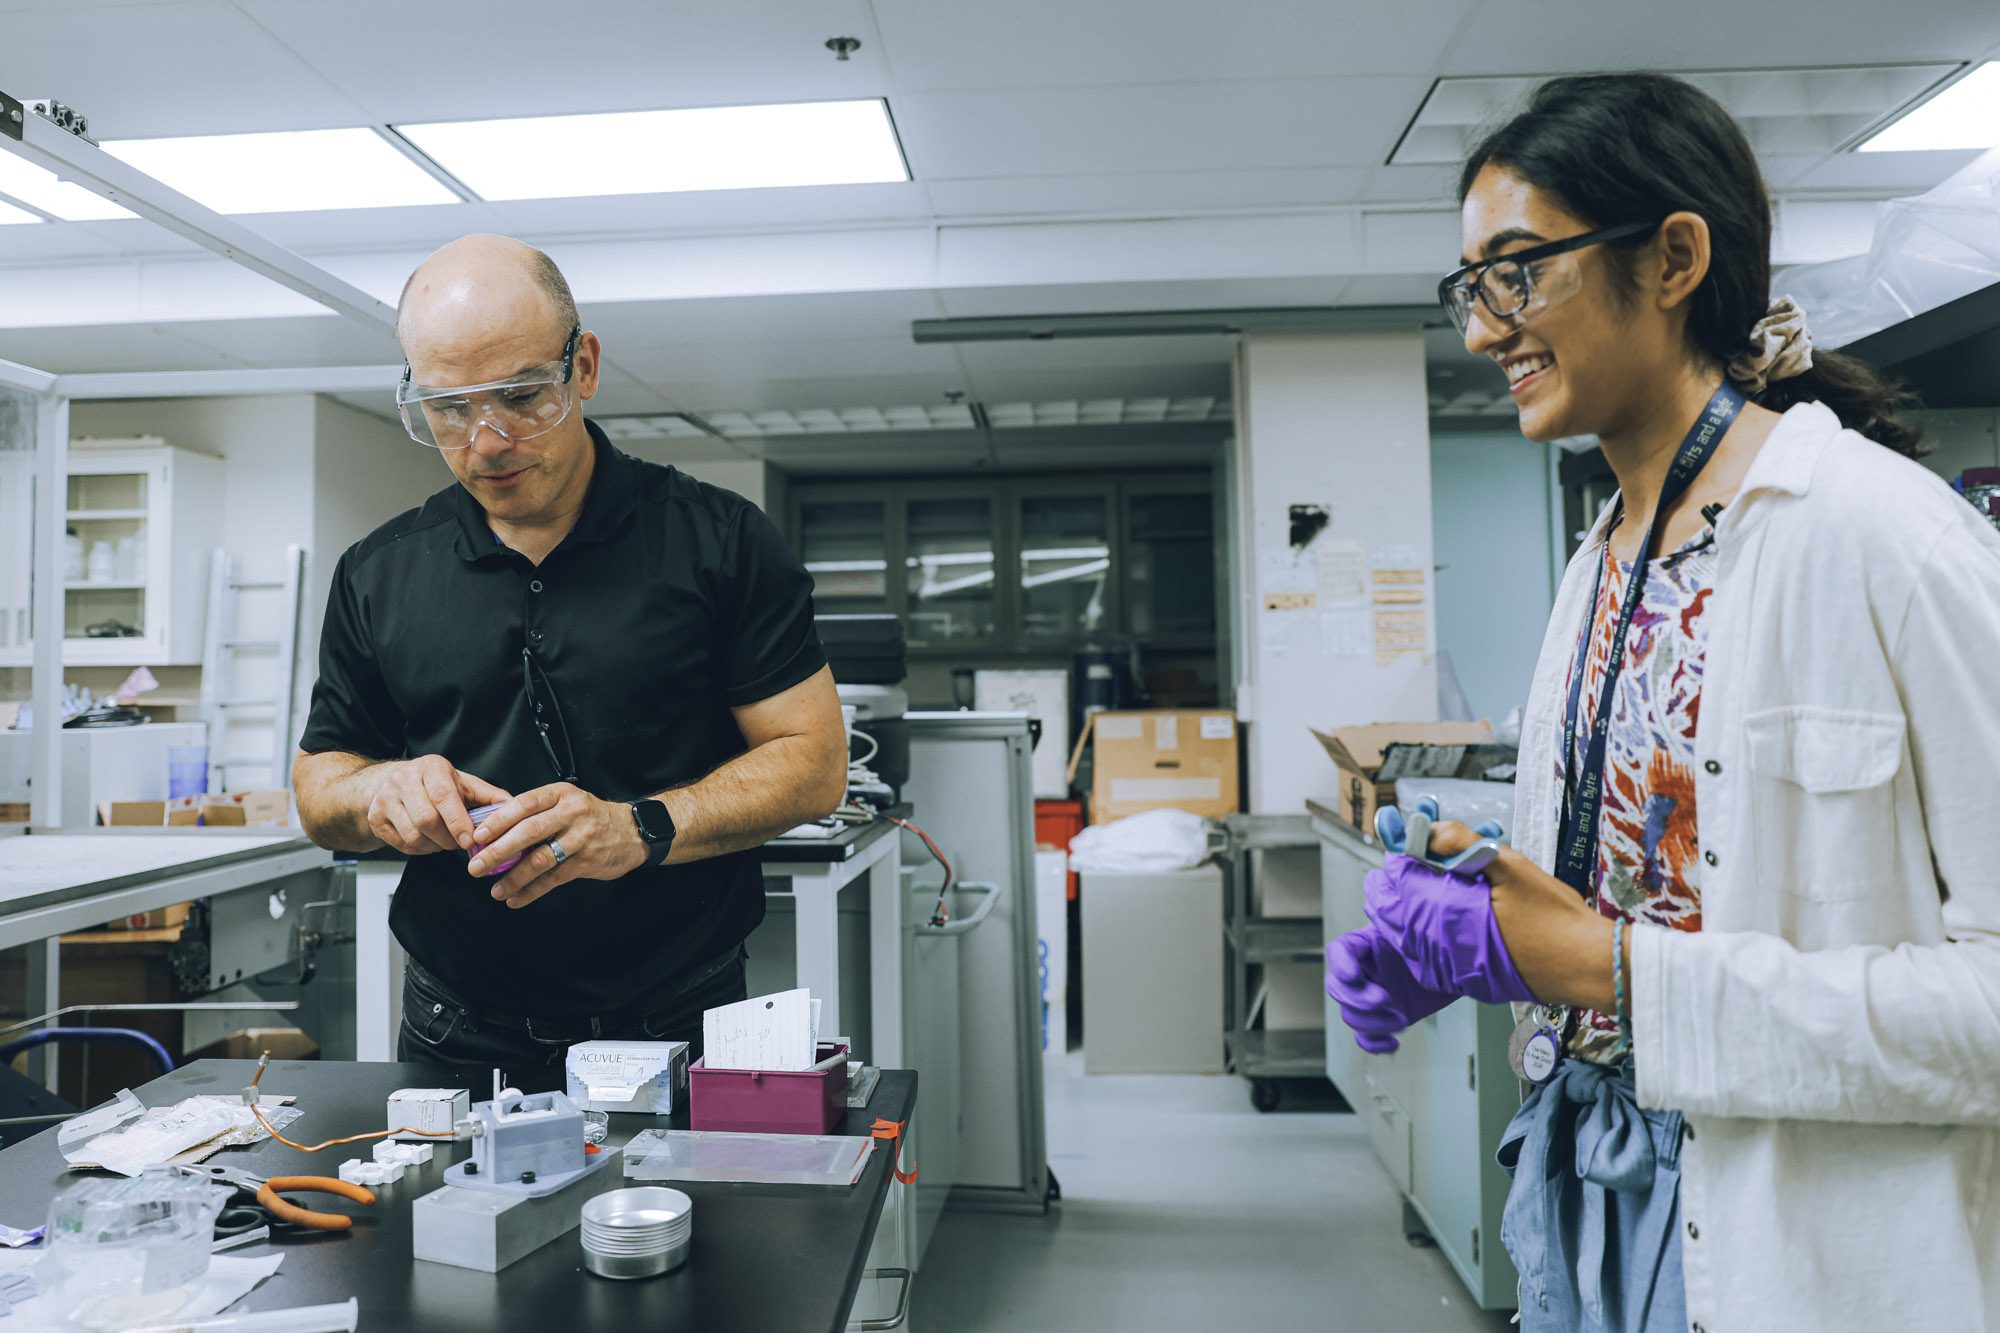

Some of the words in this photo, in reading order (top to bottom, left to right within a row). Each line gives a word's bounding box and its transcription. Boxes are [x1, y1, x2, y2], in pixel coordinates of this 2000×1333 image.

[1709, 415, 1722, 425] a
[1696, 423, 1716, 445] and
[1679, 445, 1703, 469] Bits
[1673, 468, 1687, 479] 2
[1582, 772, 1598, 799] Byte
[1583, 802, 1593, 810] a
[1579, 811, 1592, 833] and
[1569, 836, 1587, 858] Bits
[1568, 860, 1583, 870] 2
[579, 1053, 623, 1064] ACUVUE
